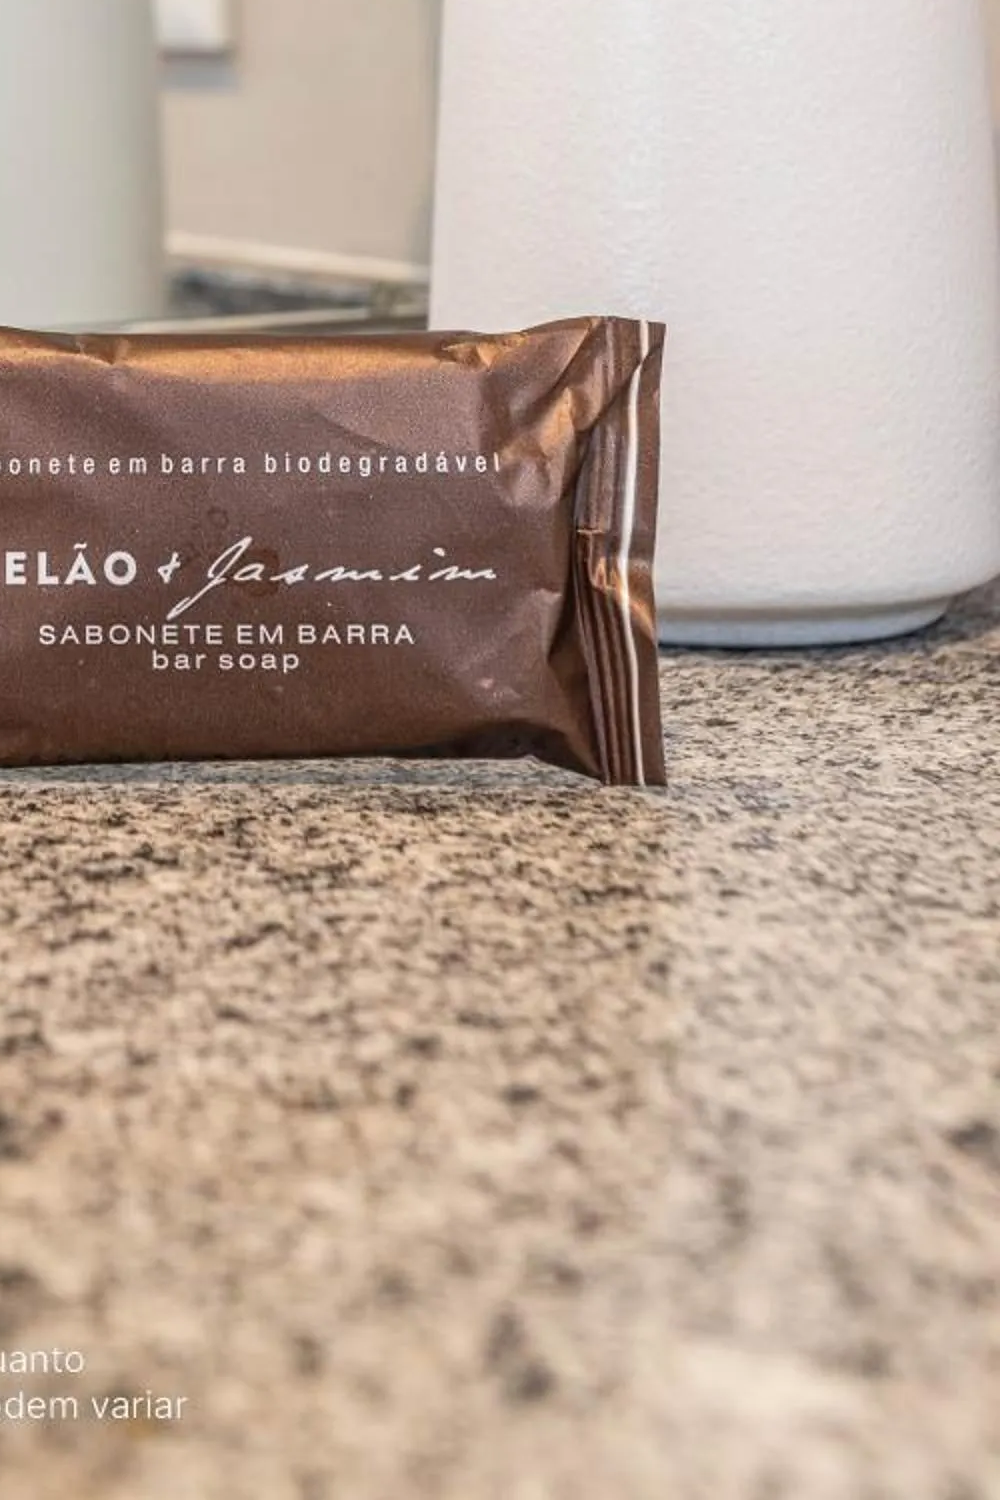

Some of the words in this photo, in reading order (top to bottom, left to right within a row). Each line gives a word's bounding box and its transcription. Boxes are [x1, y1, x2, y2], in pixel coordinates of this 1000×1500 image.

[109, 456, 148, 475] em
[161, 453, 247, 474] barra
[265, 451, 501, 477] biodegradável
[166, 536, 498, 621] Jasmim
[38, 623, 224, 646] SABONETE
[237, 623, 284, 645] EM
[297, 623, 416, 645] BARRA
[151, 649, 207, 670] bar
[218, 652, 300, 674] soap
